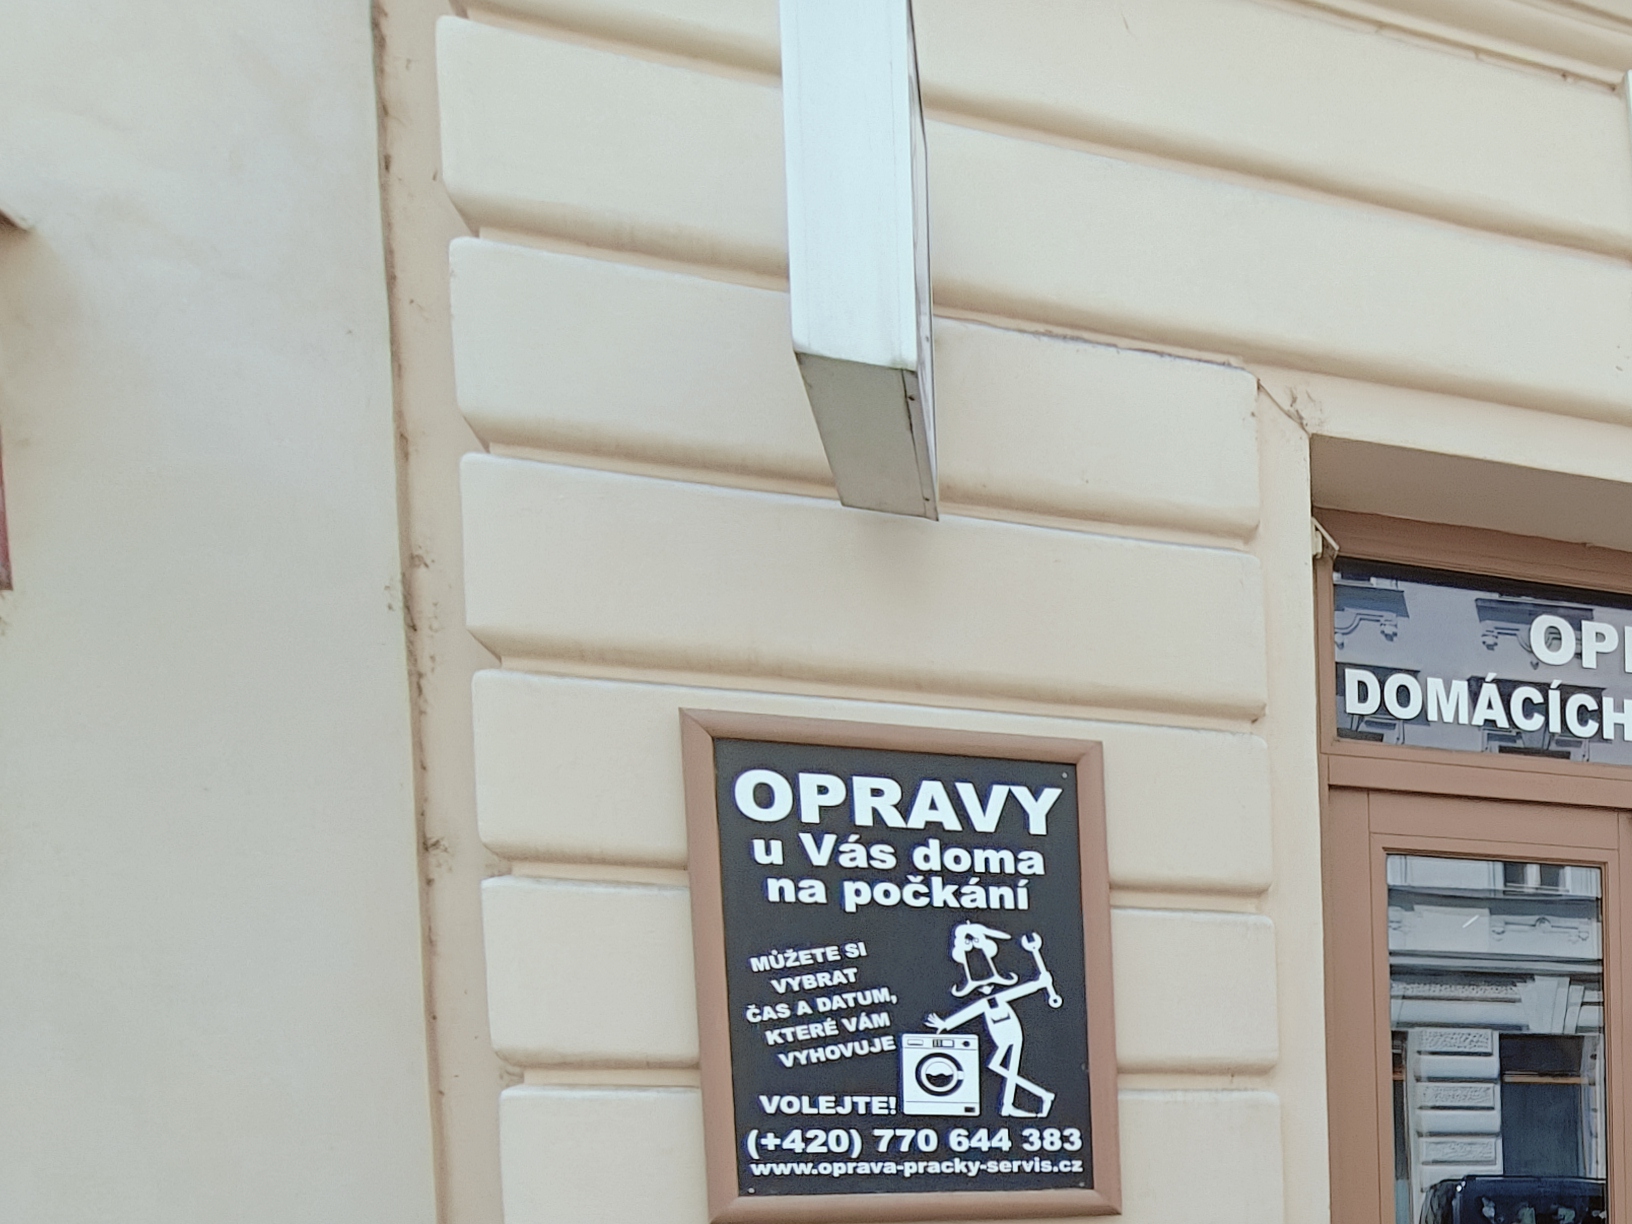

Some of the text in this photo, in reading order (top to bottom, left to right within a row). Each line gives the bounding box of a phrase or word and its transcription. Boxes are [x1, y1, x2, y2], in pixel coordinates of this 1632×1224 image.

[733, 768, 1063, 836] OPRAVY
[752, 832, 1046, 875] u Vás doma
[767, 874, 1031, 913] na počkání
[750, 941, 868, 973] MŮŽETE SI
[770, 967, 858, 994] VYBRAT
[746, 987, 898, 1024] ČAS A DATUM,
[765, 1012, 891, 1046] KTERÉ VÁM
[777, 1035, 897, 1068] VYHOVUJE
[758, 1095, 897, 1116] VOLEJTE!
[746, 1127, 1083, 1160] (+420) 770 644 383
[749, 1156, 1084, 1178] www.oprava-pracky-servis.cz
